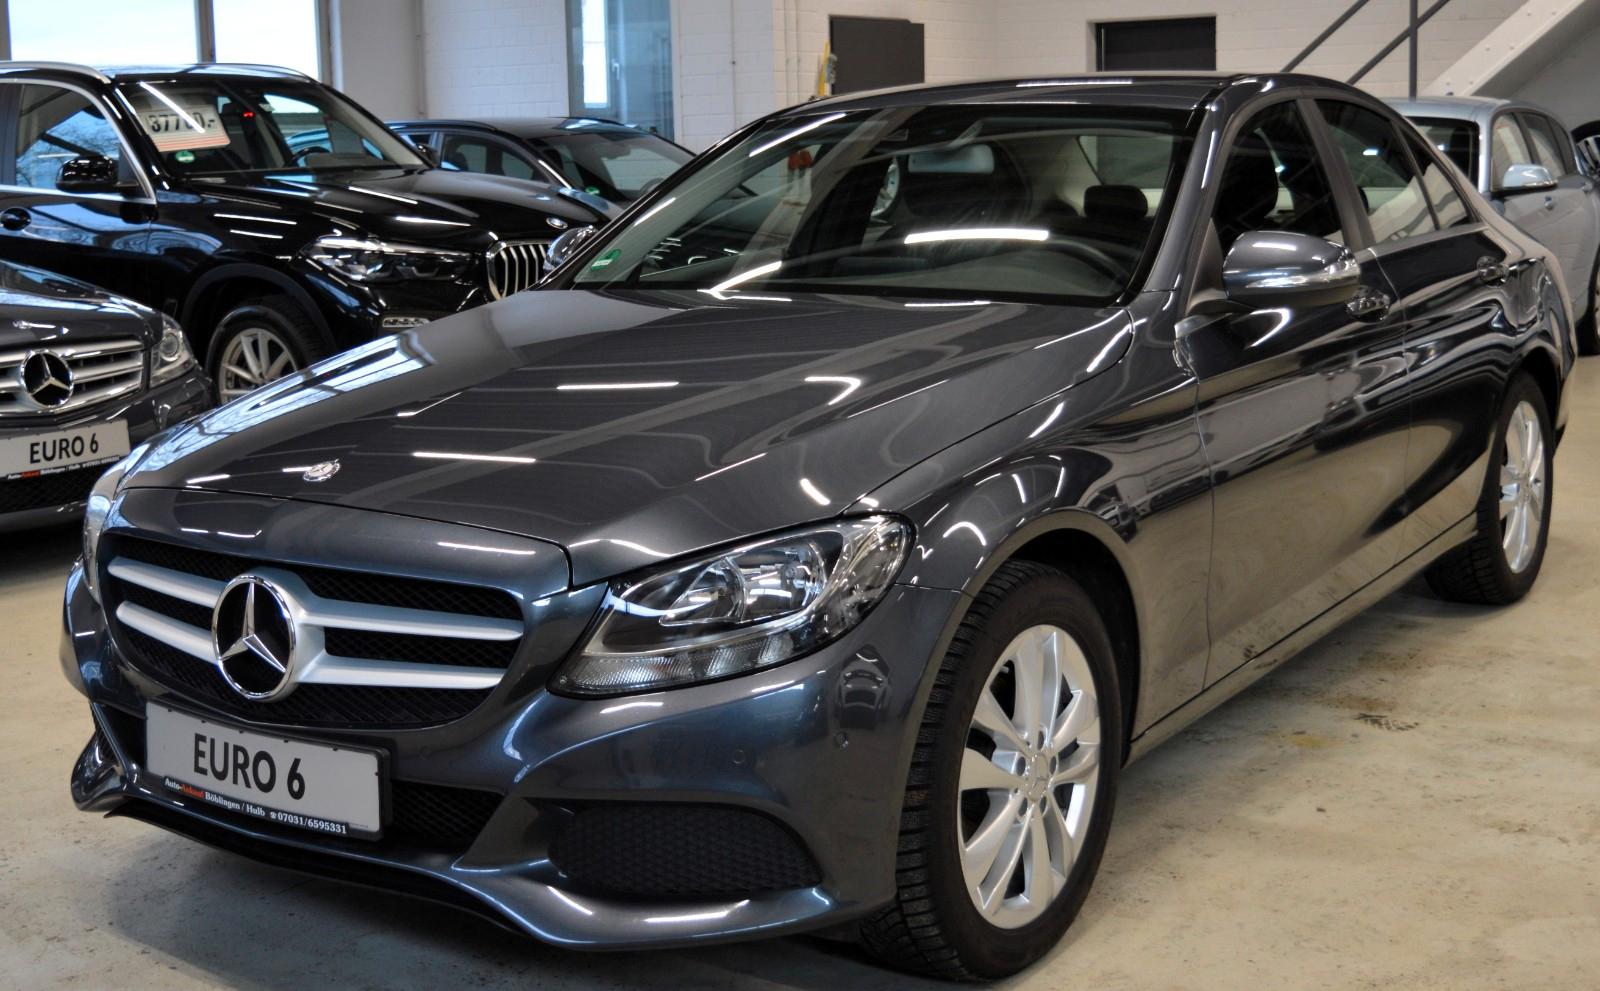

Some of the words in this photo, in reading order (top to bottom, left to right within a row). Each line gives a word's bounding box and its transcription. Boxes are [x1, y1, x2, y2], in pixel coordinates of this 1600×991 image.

[30, 436, 84, 463] EURO
[90, 433, 99, 454] 6
[194, 733, 276, 793] EURO
[287, 758, 306, 801] 6
[205, 792, 240, 810] Böblingen
[246, 803, 266, 817] Hulb
[277, 812, 347, 834] 07031/6595331
